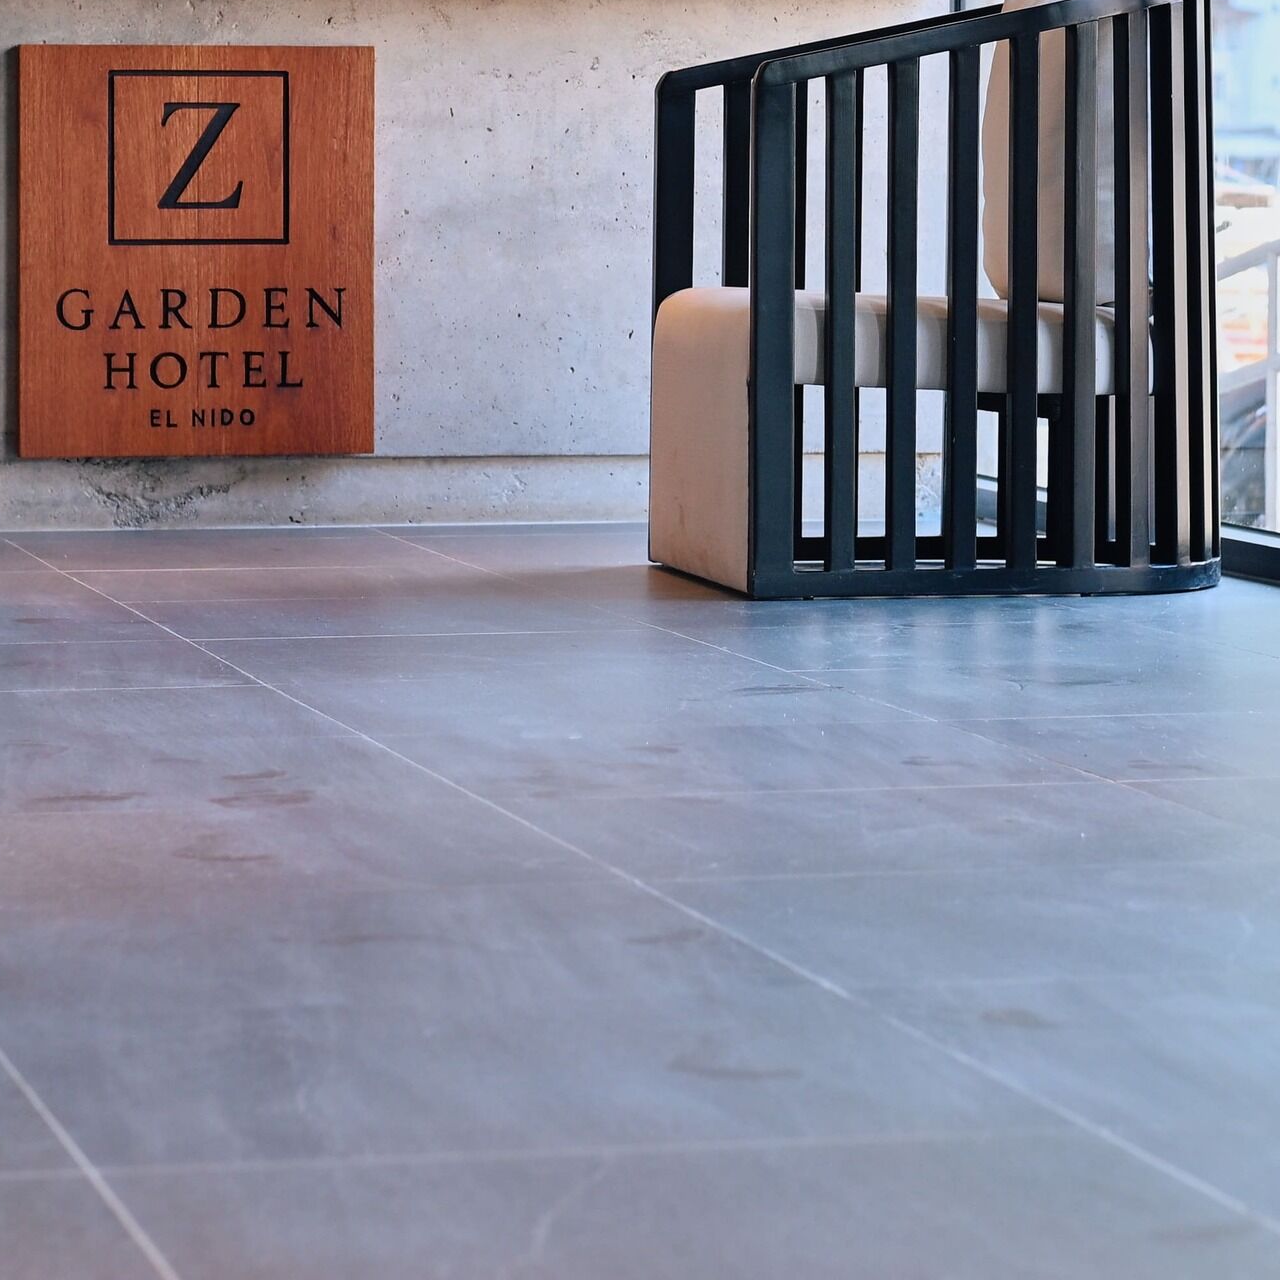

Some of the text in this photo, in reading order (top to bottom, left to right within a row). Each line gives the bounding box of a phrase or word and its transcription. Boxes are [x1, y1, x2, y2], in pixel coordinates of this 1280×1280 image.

[157, 102, 244, 209] Z
[56, 287, 346, 331] GARDEN
[103, 351, 304, 390] HOTEL
[150, 408, 256, 428] EL NIDO
